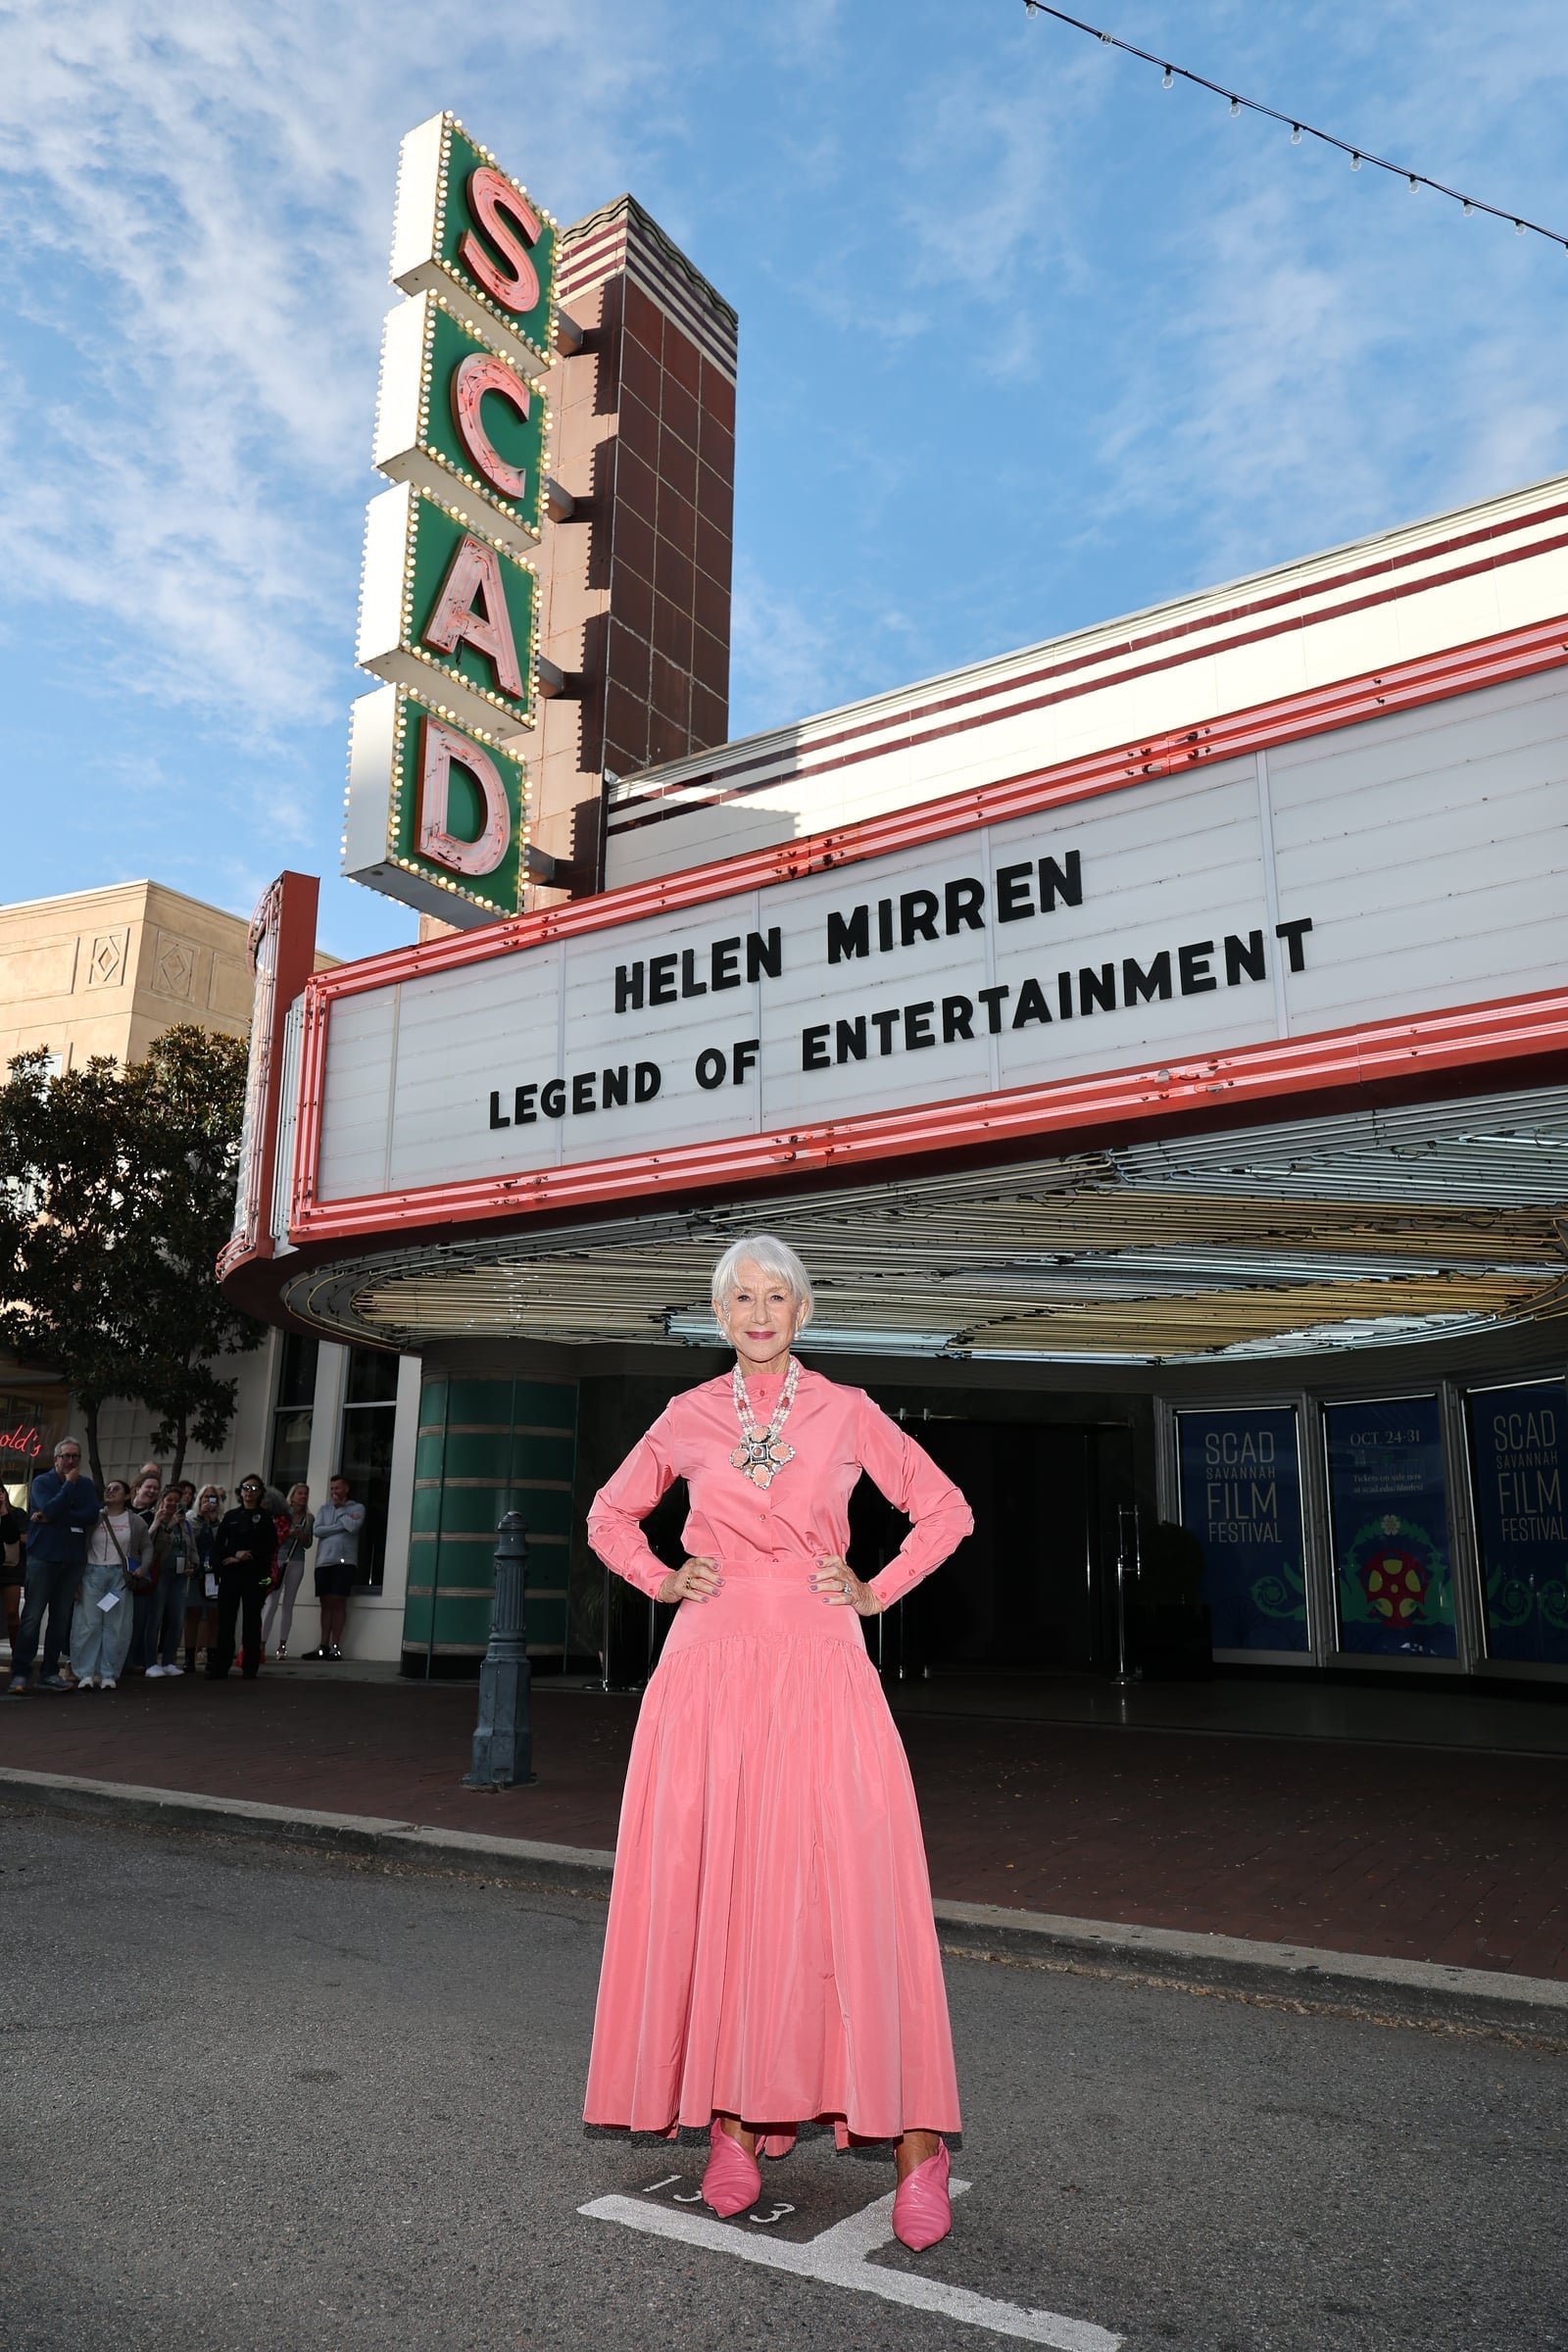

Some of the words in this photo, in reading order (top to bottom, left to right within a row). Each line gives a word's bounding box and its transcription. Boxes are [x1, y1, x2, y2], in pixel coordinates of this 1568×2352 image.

[414, 165, 542, 877] SCAD
[614, 927, 782, 1014] HELEN
[827, 849, 1083, 965] MIRREN
[489, 1061, 662, 1130] LEGEND
[695, 1039, 760, 1091] OF
[804, 918, 1313, 1070] ENTERTAINMENT
[1205, 1432, 1275, 1464] SCAD
[1349, 1431, 1383, 1446] OCT.
[1386, 1429, 1420, 1444] 24-31
[1494, 1409, 1557, 1452] SCAD
[1206, 1465, 1276, 1481] SAVANNAH
[1496, 1450, 1558, 1469] SAVANNAH
[1206, 1482, 1278, 1520] FILM
[1497, 1468, 1562, 1515] FILM
[1208, 1522, 1283, 1543] FESTIVAL
[1501, 1515, 1568, 1543] FESTIVAL
